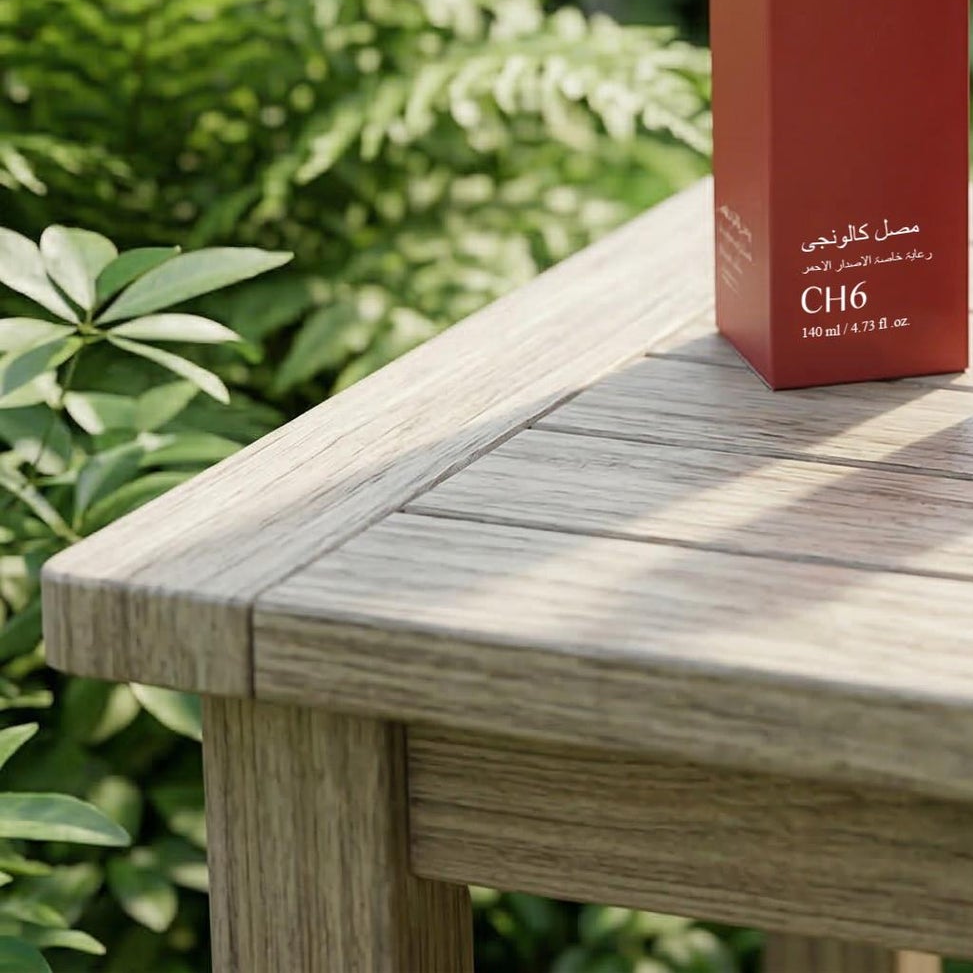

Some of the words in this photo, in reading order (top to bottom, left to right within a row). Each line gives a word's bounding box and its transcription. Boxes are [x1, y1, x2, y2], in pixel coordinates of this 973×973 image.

[874, 219, 920, 241] مصل
[801, 280, 868, 314] CH6
[802, 326, 823, 338] 140
[825, 324, 841, 337] ml
[851, 320, 875, 334] 4.73
